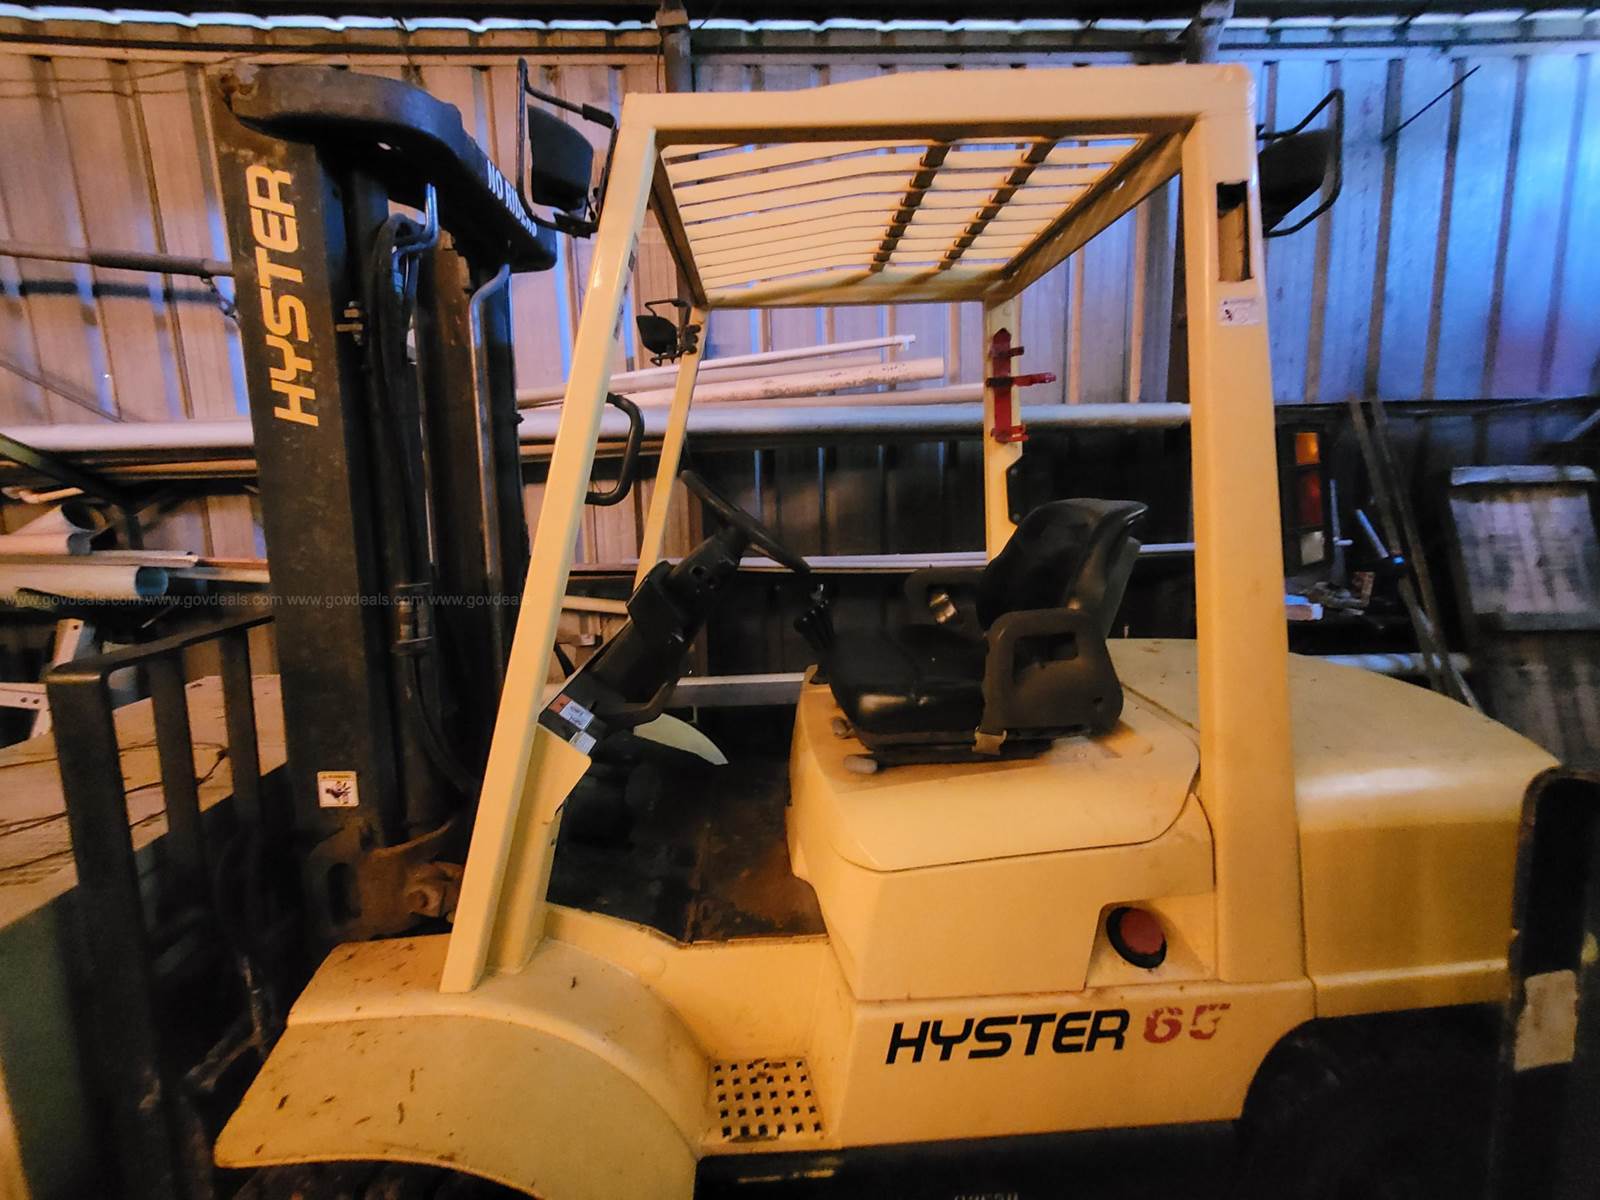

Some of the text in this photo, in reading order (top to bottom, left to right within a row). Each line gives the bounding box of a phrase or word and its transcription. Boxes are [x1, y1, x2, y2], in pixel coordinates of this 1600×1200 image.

[487, 160, 504, 200] NO
[246, 164, 319, 427] HYSTER
[885, 1002, 1231, 1065] HYSTER 65
